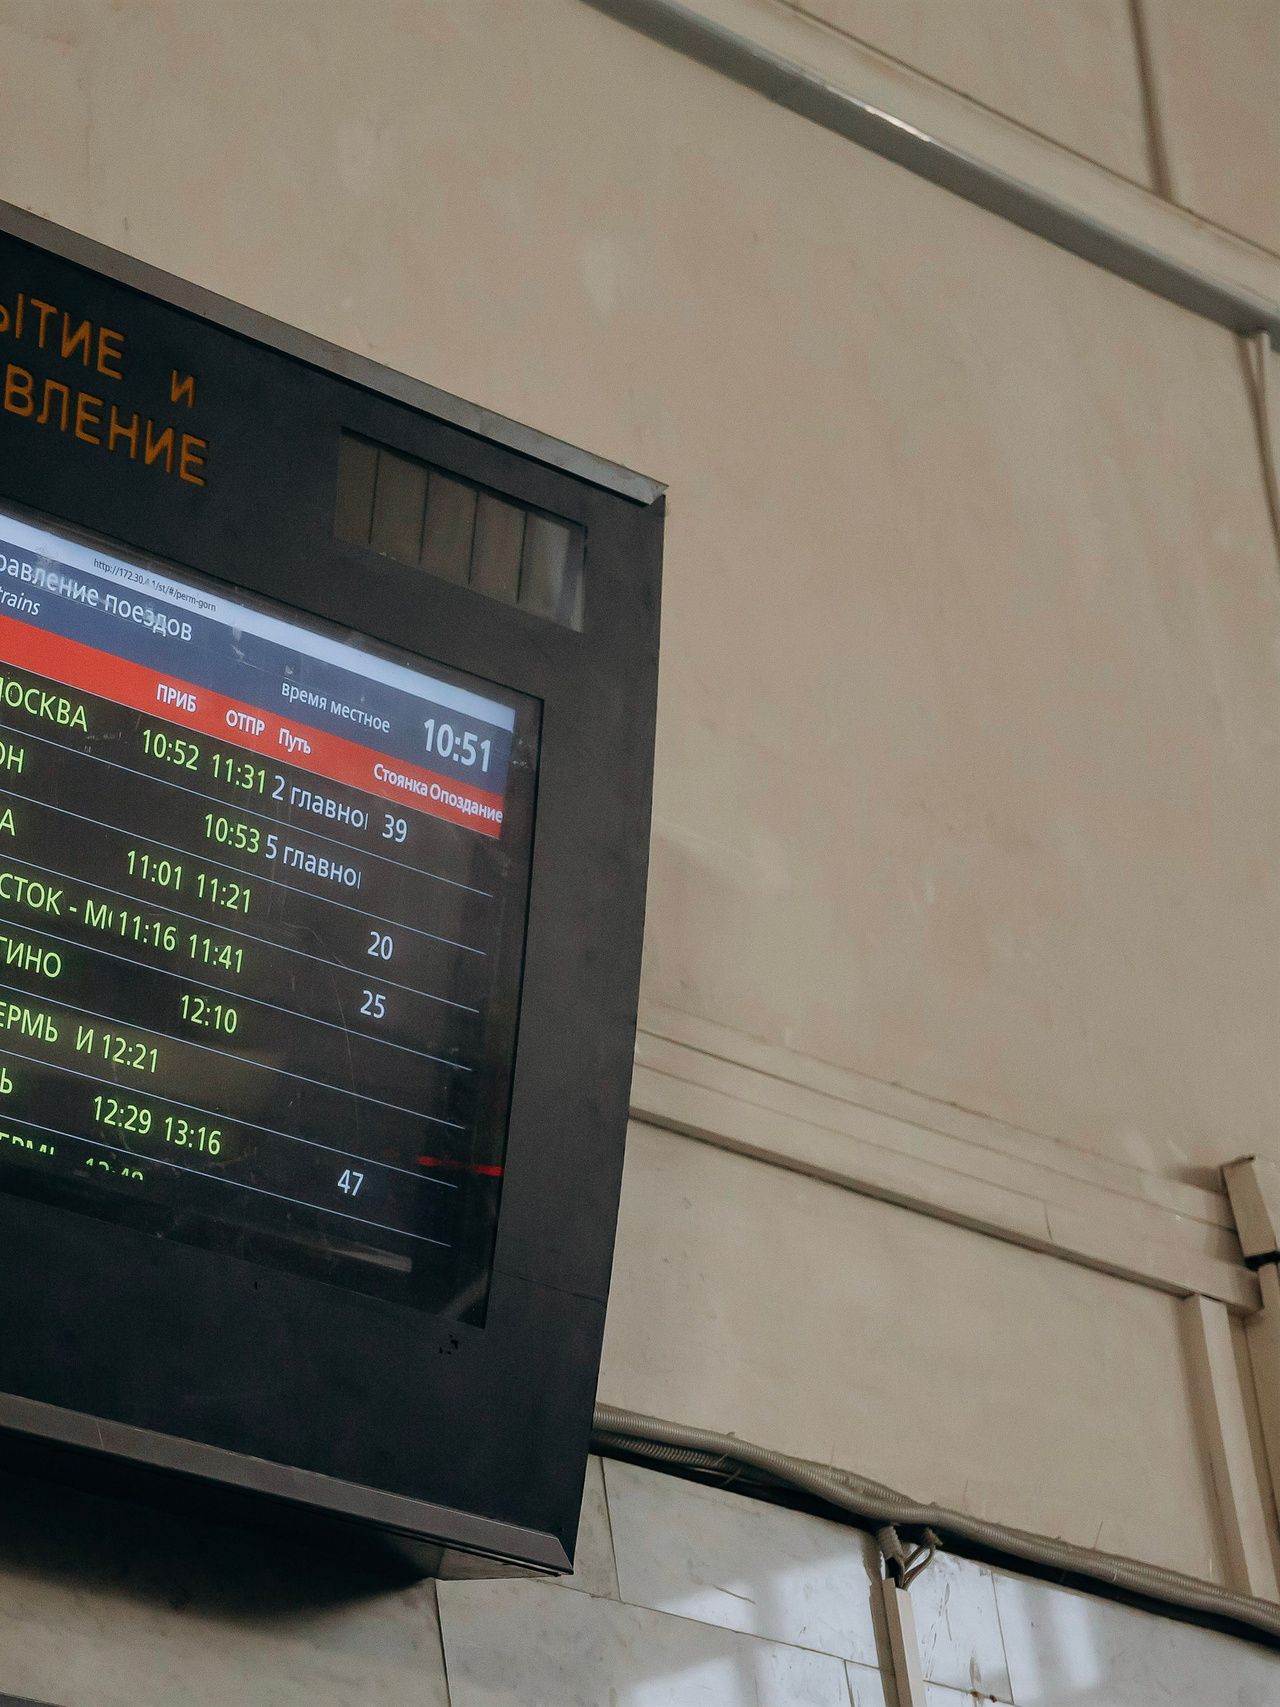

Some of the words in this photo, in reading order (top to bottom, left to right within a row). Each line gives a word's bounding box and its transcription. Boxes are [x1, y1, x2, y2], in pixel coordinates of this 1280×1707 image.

[93, 558, 217, 612] http://172.30.1/st/#/perm-gorn
[105, 593, 193, 641] поездов
[156, 684, 197, 712] ПРИБ
[226, 709, 266, 736] ОТПР
[278, 728, 312, 756] Путь
[373, 763, 428, 797] Стоянка
[430, 783, 504, 824] Опоздание
[282, 682, 328, 711] время
[330, 702, 391, 733] местное
[424, 718, 491, 773] 10:51
[142, 729, 199, 771] 10:52
[212, 754, 266, 794] 11:31
[272, 775, 286, 801] 2
[290, 787, 369, 830] главно
[382, 814, 409, 843] 39
[204, 814, 261, 854] 10:53
[265, 834, 279, 859] 5
[283, 846, 362, 889] главно
[126, 851, 183, 890] 11:01
[197, 873, 251, 913] 11:21
[367, 932, 394, 960] 20
[84, 900, 113, 930] М
[120, 911, 177, 951] 11:16
[189, 934, 243, 974] 11:41
[360, 990, 386, 1019] 25
[103, 1034, 158, 1073] 12:21
[181, 995, 238, 1034] 12:10
[93, 1095, 152, 1135] 12:29
[164, 1117, 221, 1155] 13:16
[337, 1169, 365, 1197] 47
